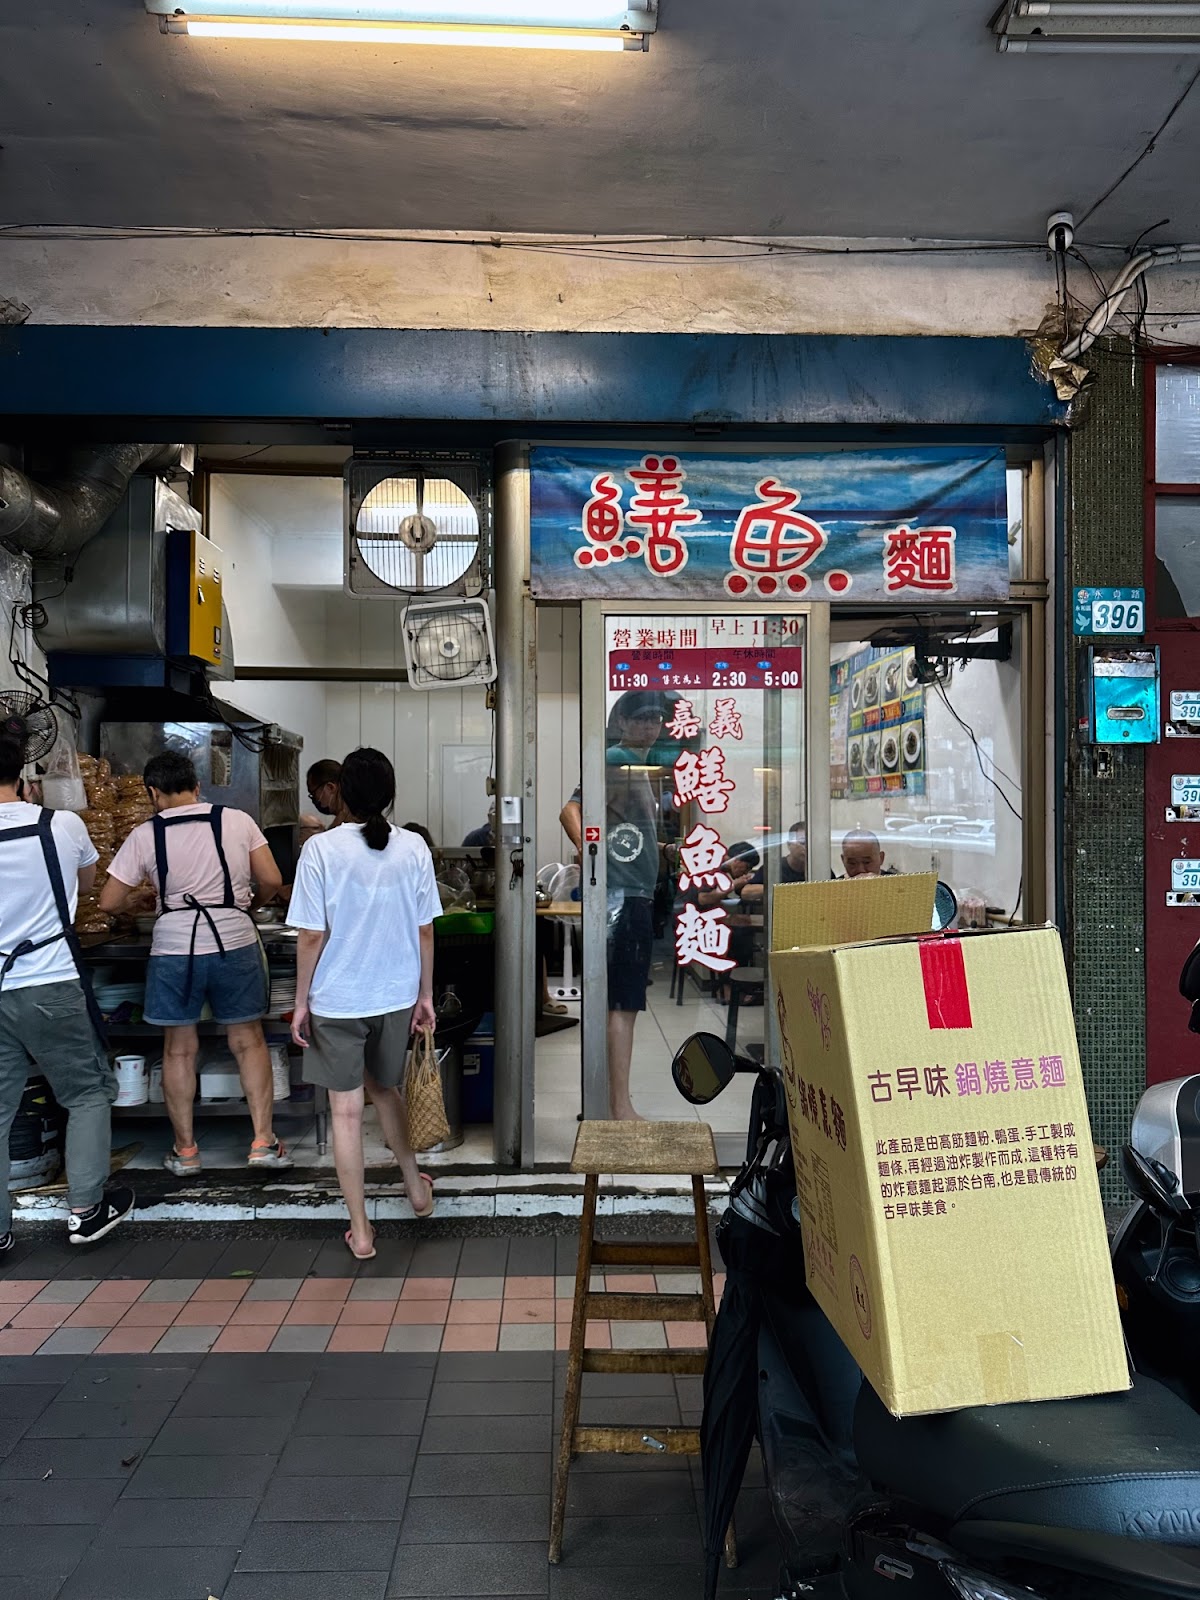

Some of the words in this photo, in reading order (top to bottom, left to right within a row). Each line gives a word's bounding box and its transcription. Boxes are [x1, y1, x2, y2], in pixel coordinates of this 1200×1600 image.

[575, 455, 957, 595] 鱔魚麵
[1094, 589, 1140, 599] 永貞路
[1095, 604, 1140, 629] 396
[710, 619, 744, 635] 早上
[752, 619, 799, 635] 11:30
[613, 628, 697, 647] 營業時間
[631, 650, 674, 660] 營業時間
[732, 649, 776, 659] 午休時間
[611, 673, 648, 687] 11:30
[662, 674, 701, 685] 售完為止
[712, 671, 747, 686] 2:30
[764, 670, 799, 686] 5:00
[665, 697, 743, 740] 嘉義
[673, 745, 737, 972] 鱔魚麵
[867, 1063, 951, 1103] 古早味
[954, 1055, 1066, 1097] 鍋燒意麵
[883, 1198, 956, 1220] 古早味美食。
